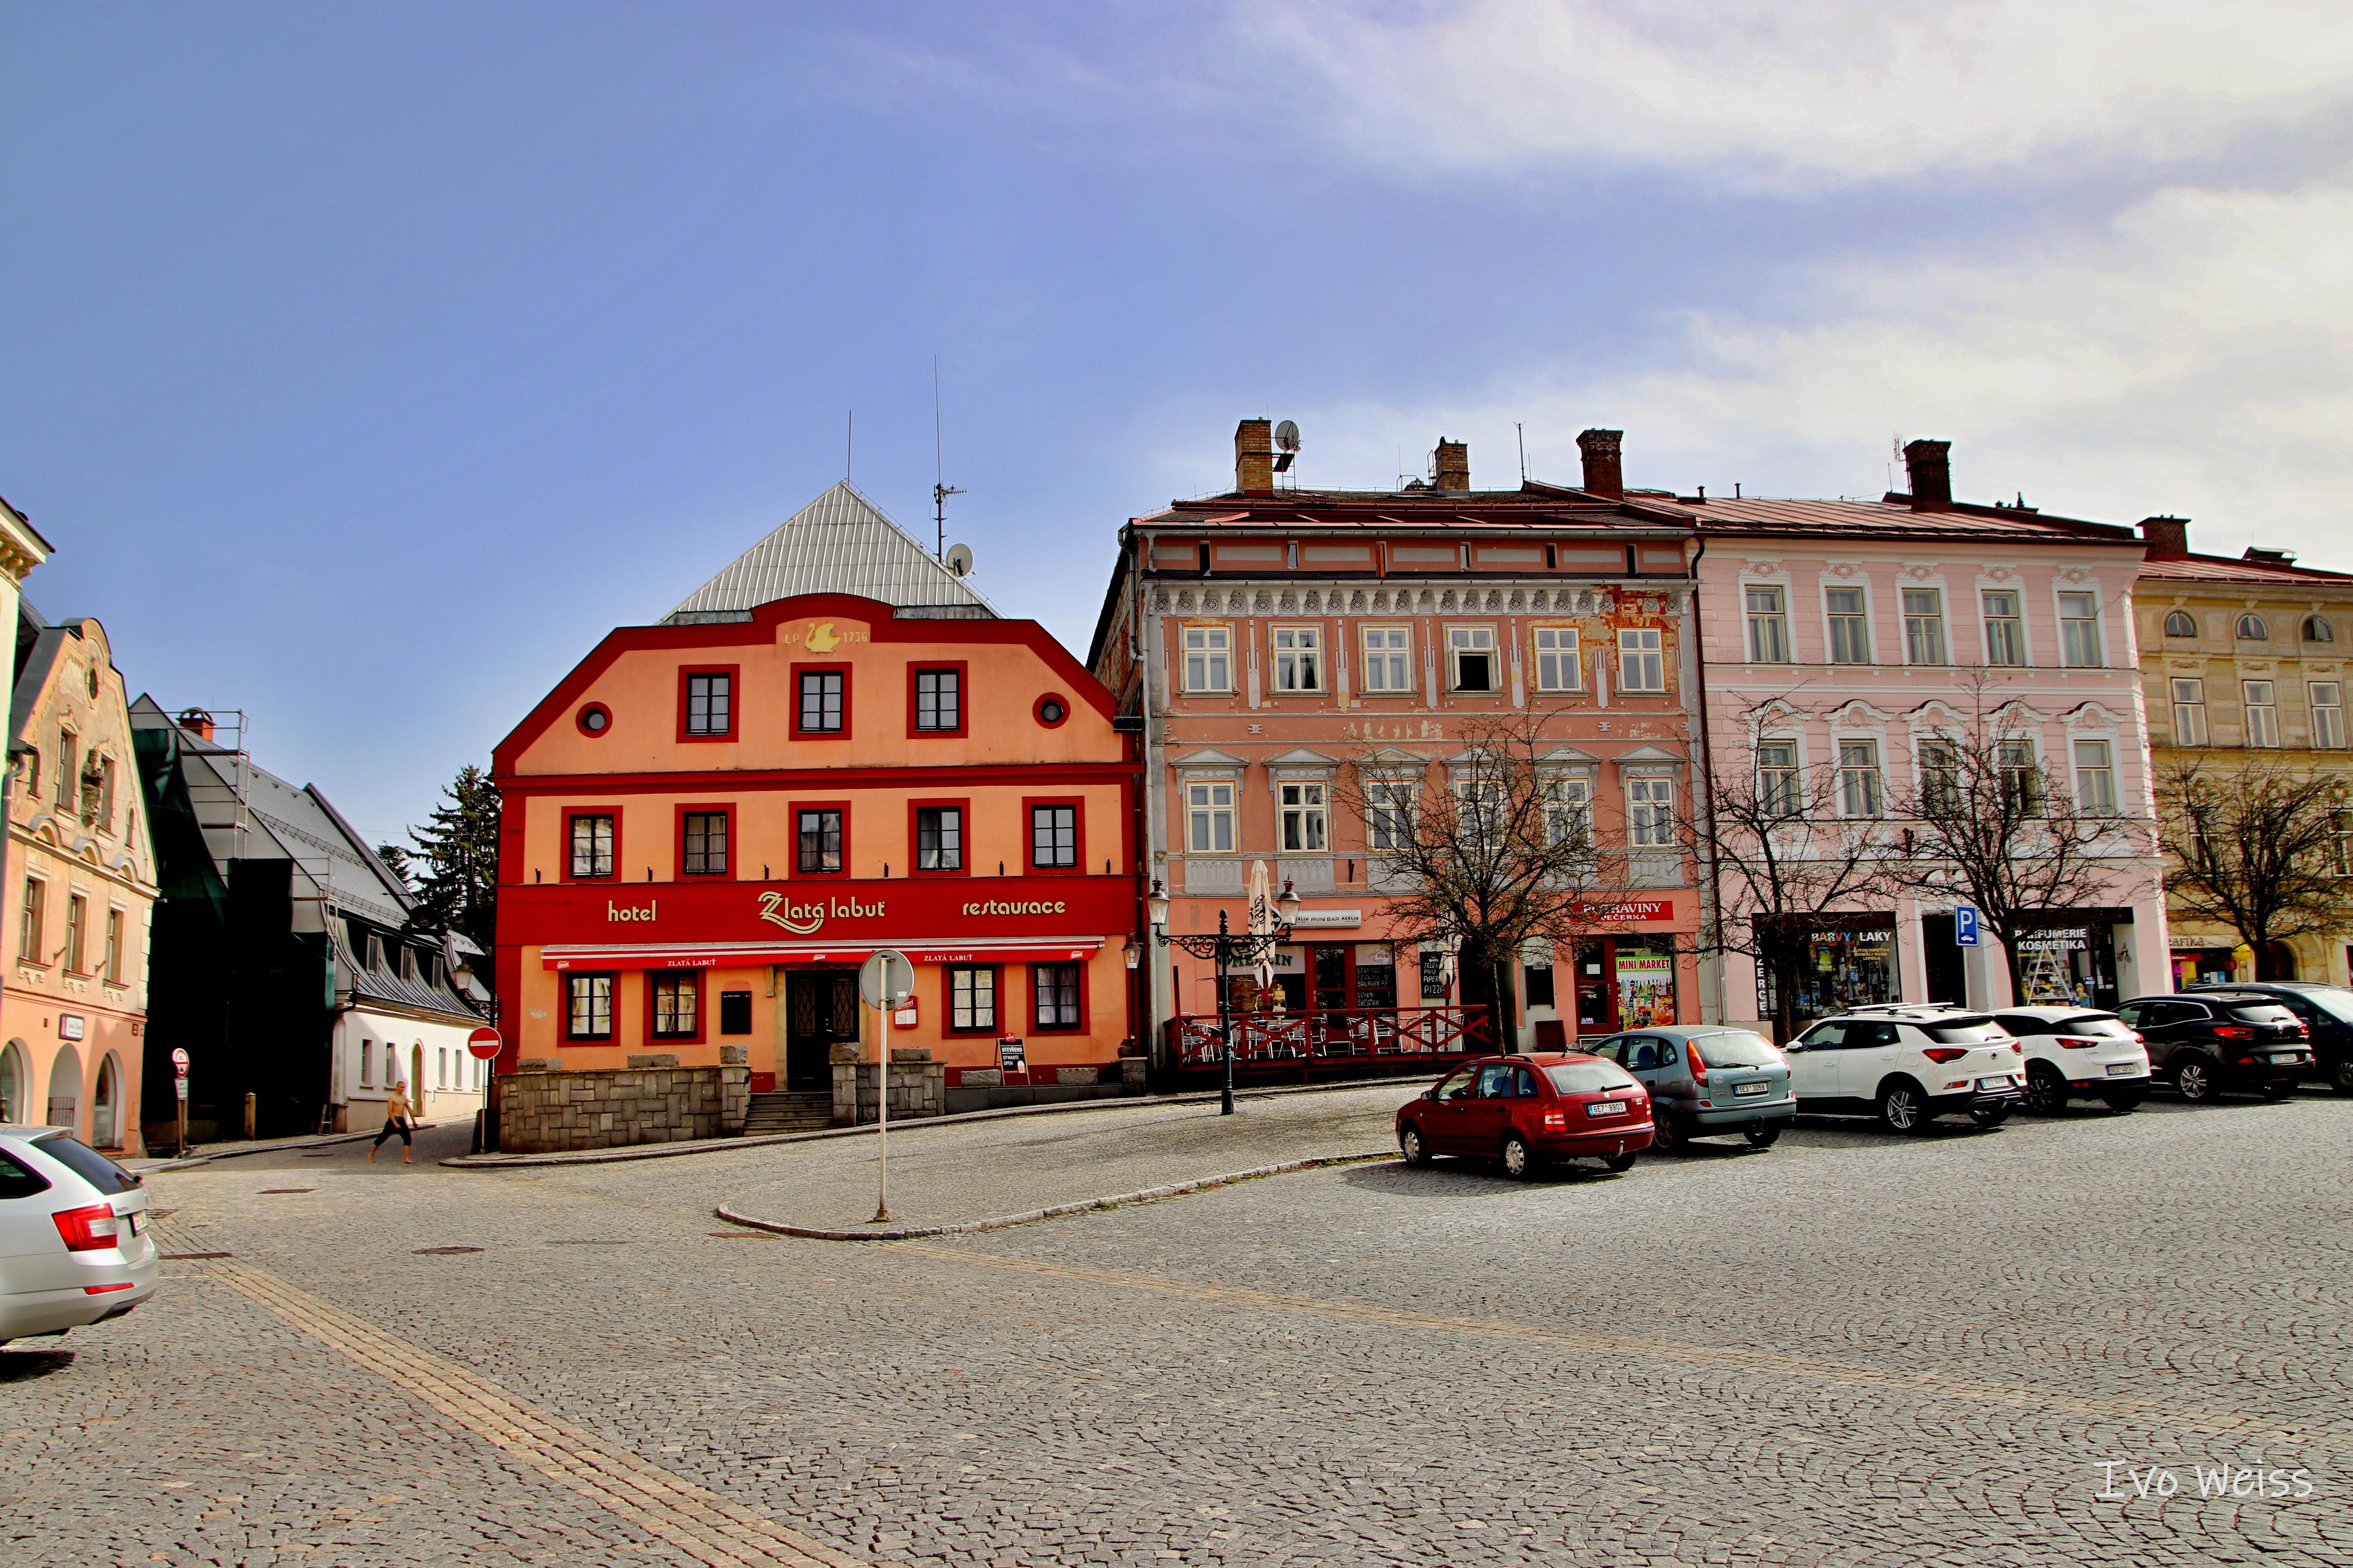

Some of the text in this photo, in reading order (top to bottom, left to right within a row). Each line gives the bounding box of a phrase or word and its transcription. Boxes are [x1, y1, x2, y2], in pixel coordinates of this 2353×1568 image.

[843, 632, 868, 642] 1736
[608, 899, 656, 922] hotel
[963, 900, 1066, 915] restaurace
[758, 891, 885, 935] Zlatá labuť
[1960, 910, 1973, 933] P
[1811, 932, 1891, 942] BARVY LAKY
[2018, 940, 2086, 950] KOSMETIKA
[1619, 959, 1669, 969] MINI MARKET
[1424, 985, 1445, 994] PIZZA
[1739, 1083, 1765, 1093] 5E3 3058
[1593, 1103, 1624, 1113] 6E7 9903
